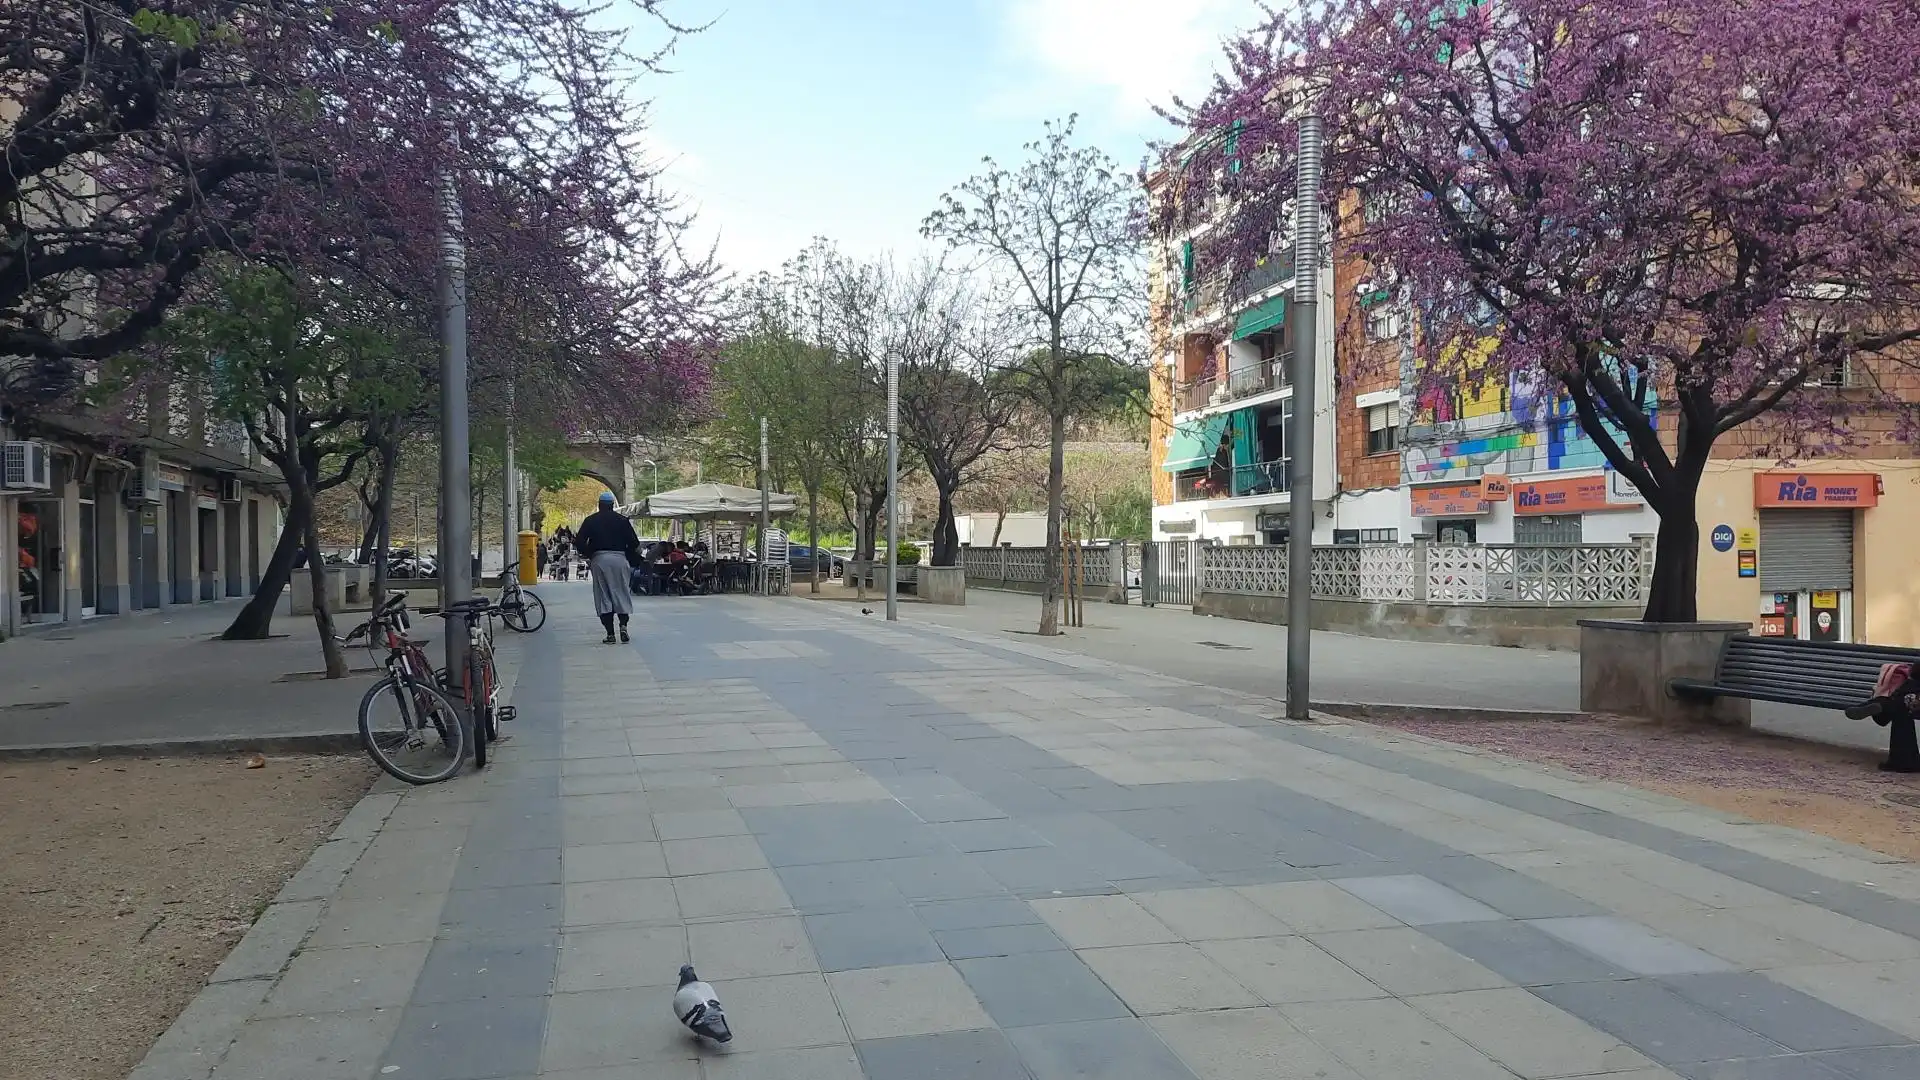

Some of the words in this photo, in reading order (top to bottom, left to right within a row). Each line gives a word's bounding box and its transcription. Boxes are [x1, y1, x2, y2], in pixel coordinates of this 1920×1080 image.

[1487, 480, 1505, 491] Ria
[1778, 474, 1817, 501] Ria
[1824, 487, 1858, 495] MONEY
[1518, 485, 1541, 506] Ria
[1714, 532, 1732, 541] DIGI
[1760, 620, 1777, 633] ria
